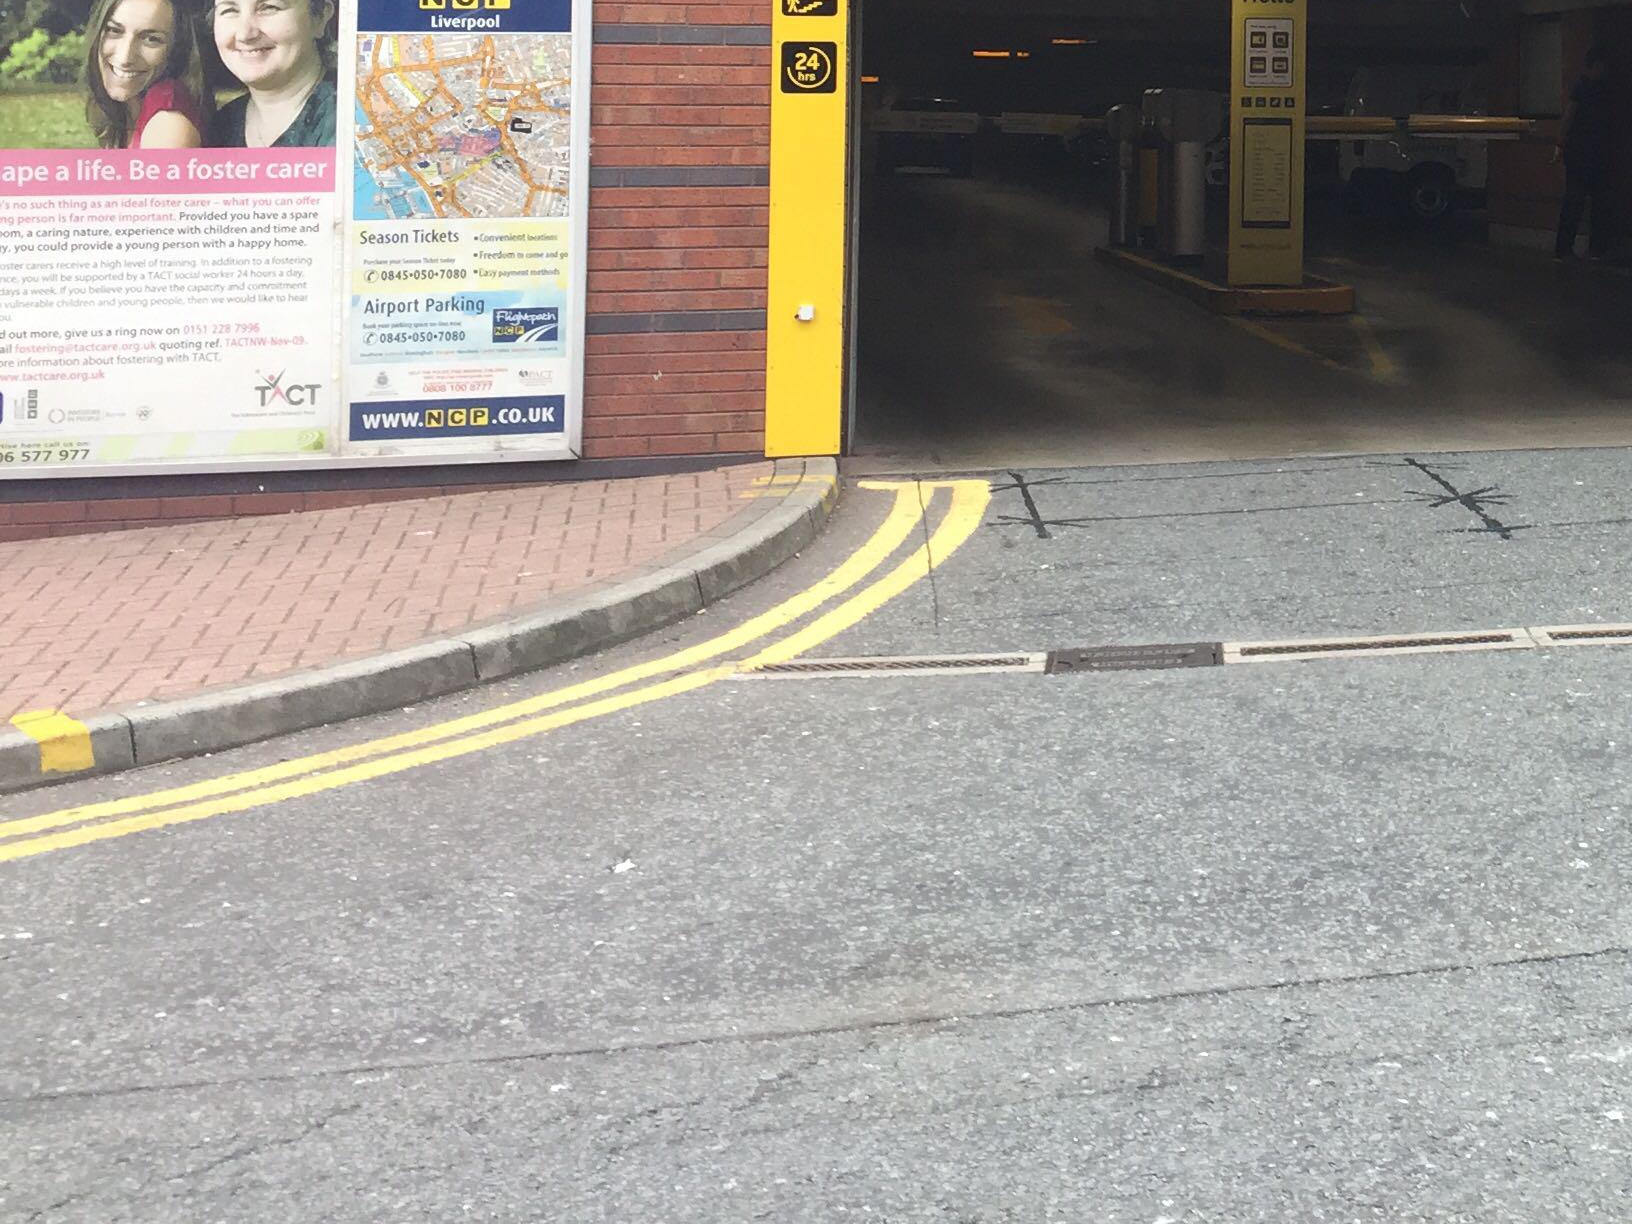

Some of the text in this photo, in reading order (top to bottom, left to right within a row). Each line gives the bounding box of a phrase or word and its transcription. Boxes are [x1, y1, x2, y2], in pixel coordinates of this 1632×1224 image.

[431, 15, 500, 30] Liverpool
[795, 53, 820, 70] 24
[798, 72, 815, 81] hrs
[0, 158, 328, 187] ape a life. Be a foster carer
[30, 200, 55, 209] such
[58, 199, 87, 210] thing
[122, 199, 147, 207] ideal
[150, 197, 181, 207] foster
[223, 198, 249, 206] what
[252, 200, 272, 208] you
[296, 196, 320, 205] offer
[18, 215, 55, 225] person
[58, 214, 66, 222] is
[70, 214, 85, 222] far
[119, 213, 176, 223] important.
[179, 212, 227, 220] Provided
[230, 213, 250, 222] you
[253, 211, 278, 219] have
[290, 212, 318, 221] spare
[36, 228, 70, 238] caring
[115, 226, 174, 237] experience
[178, 226, 201, 234] with
[204, 225, 247, 234] children
[250, 224, 271, 233] and
[274, 224, 297, 233] time
[300, 224, 319, 233] and
[360, 229, 459, 245] Season Tickets
[15, 244, 34, 253] you
[38, 242, 68, 251] could
[71, 241, 114, 253] provide
[125, 242, 159, 253] young
[162, 240, 200, 251] person
[202, 239, 226, 248] with
[238, 239, 271, 249] happy
[274, 237, 307, 247] home.
[364, 297, 485, 316] Airport Parking
[9, 331, 26, 339] out
[30, 330, 62, 339] more,
[65, 329, 88, 340] give
[115, 327, 137, 338] ring
[140, 328, 163, 336] now
[166, 327, 180, 335] on
[184, 325, 207, 334] 0151
[212, 324, 231, 333] 228
[494, 326, 525, 335] NCP
[159, 339, 201, 350] quoting
[205, 338, 222, 348] ref.
[18, 357, 80, 367] information
[83, 355, 114, 365] about
[117, 354, 163, 364] fostering
[166, 353, 190, 363] with
[254, 383, 322, 406] TACT
[21, 450, 52, 462] 577
[59, 449, 90, 461] 977
